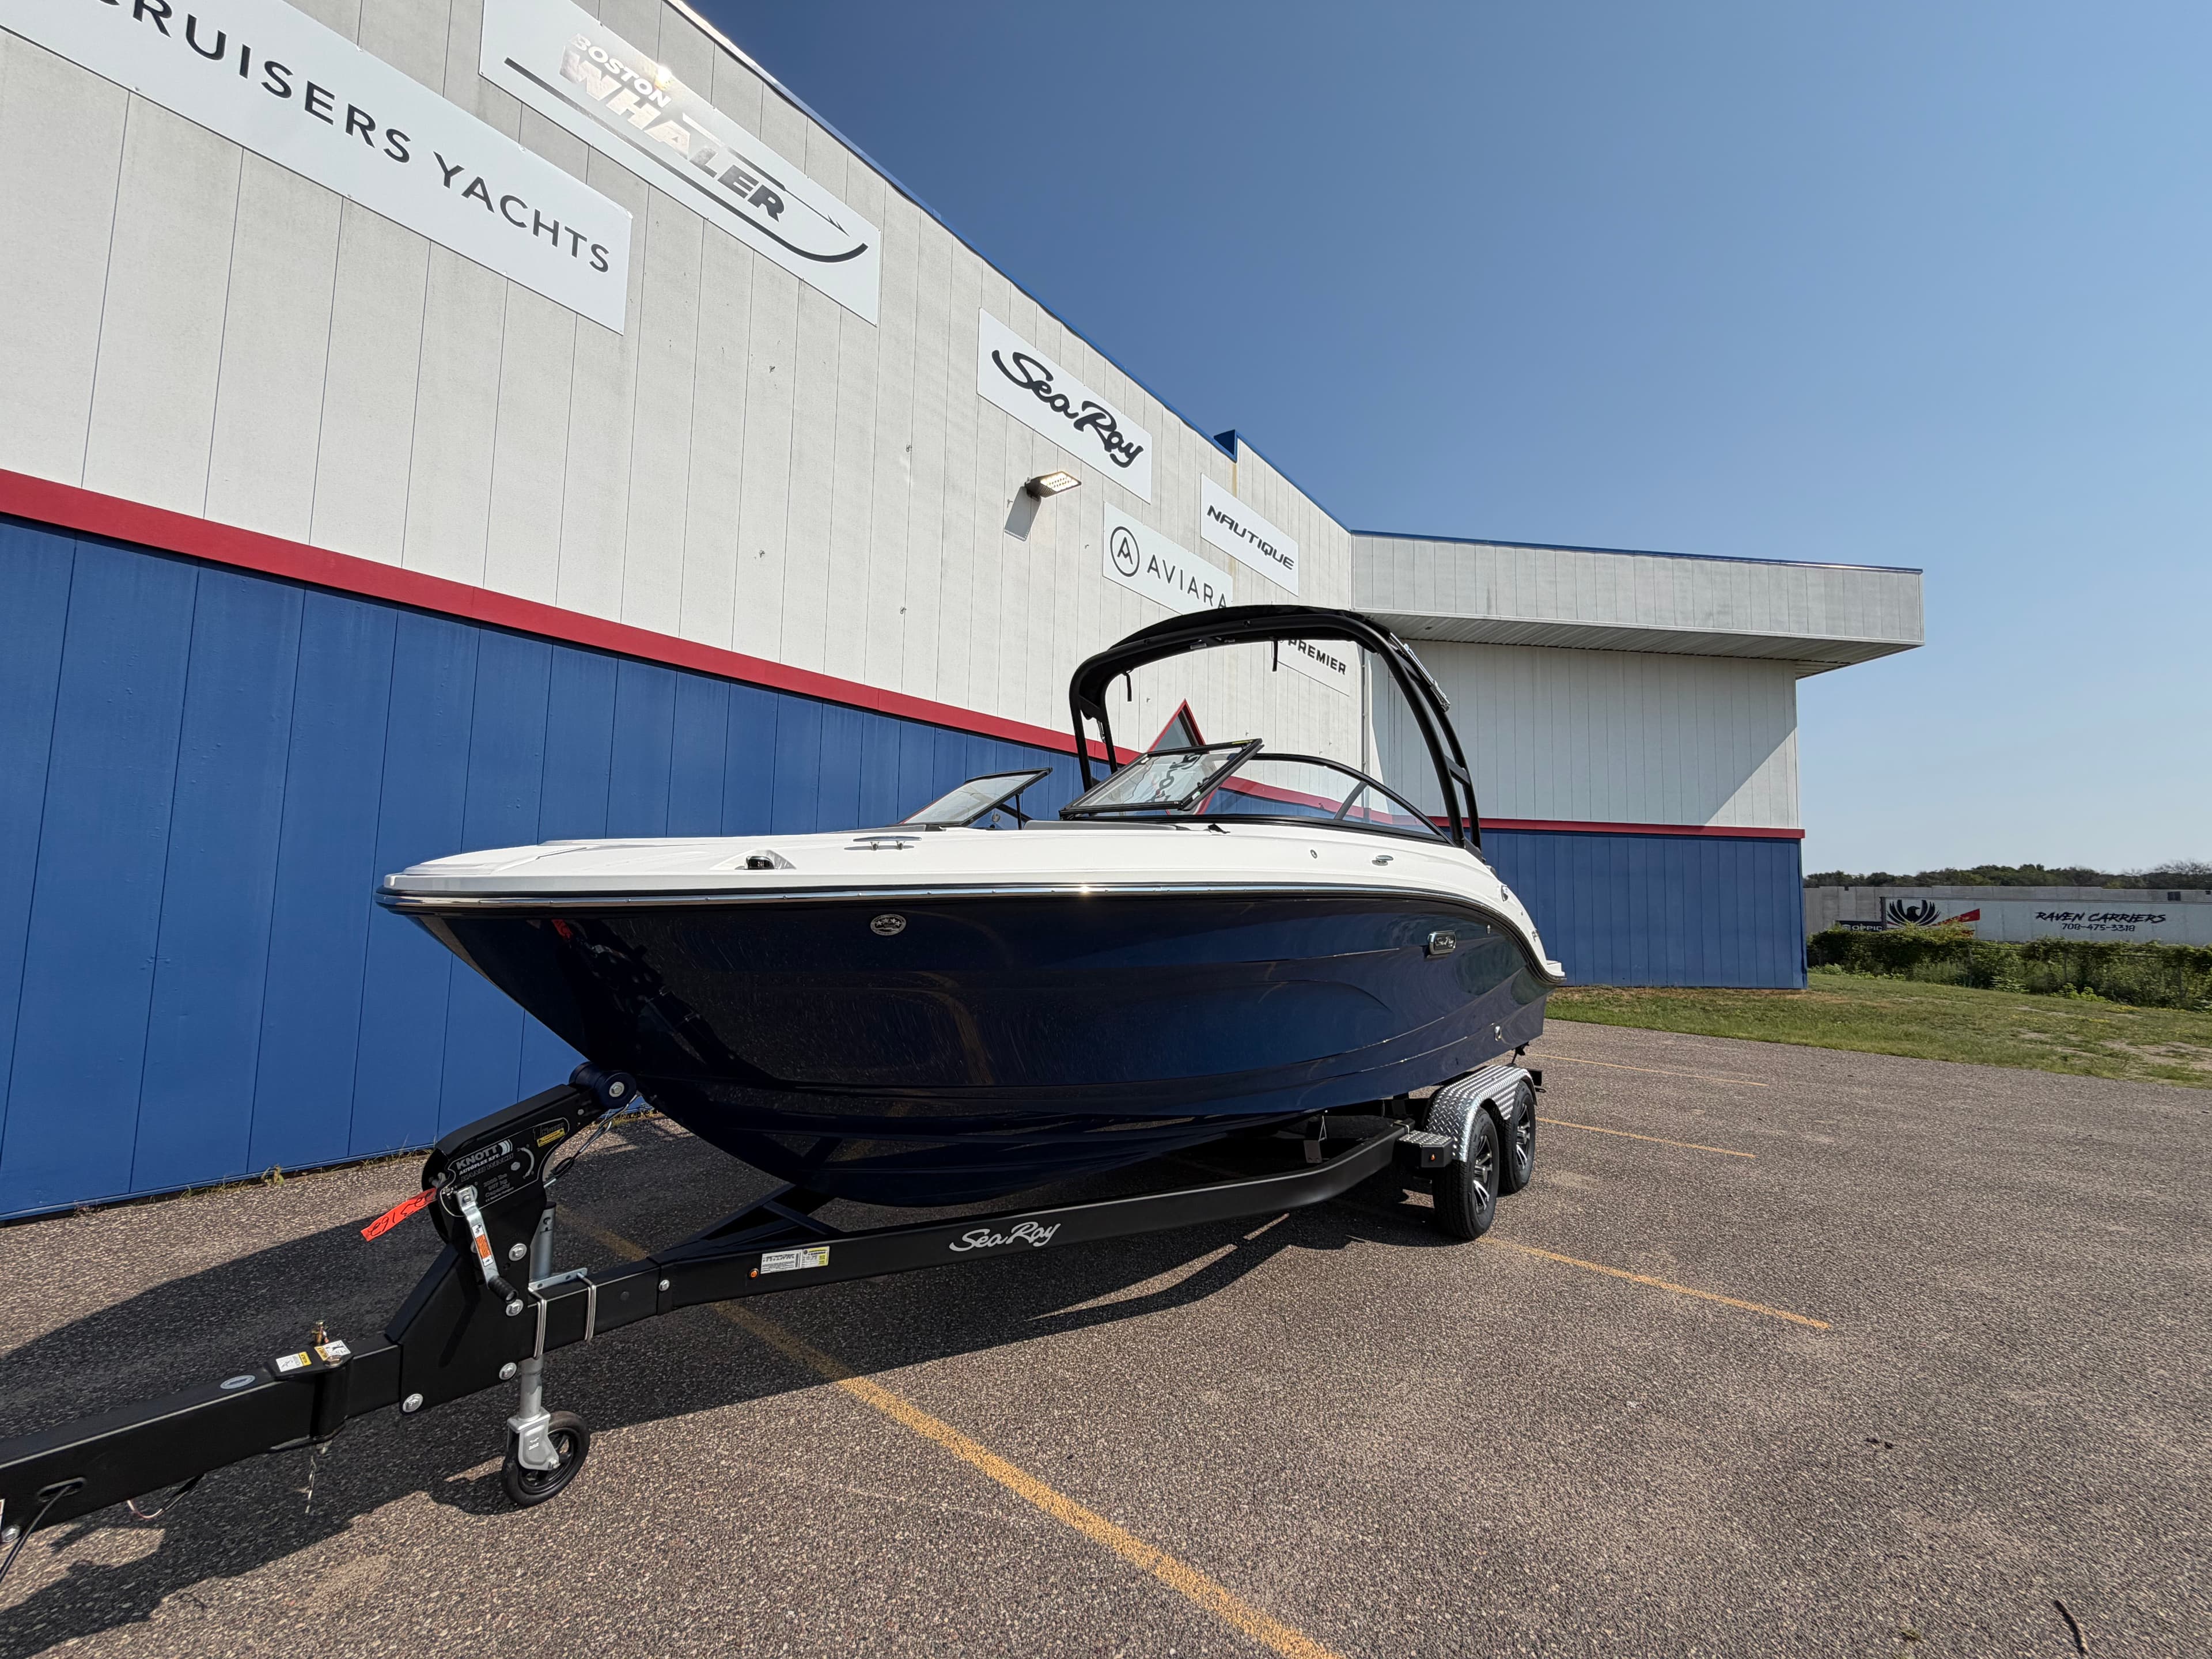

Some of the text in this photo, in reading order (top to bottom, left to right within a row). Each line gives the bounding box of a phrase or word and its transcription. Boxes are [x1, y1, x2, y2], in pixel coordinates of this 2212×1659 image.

[571, 33, 672, 108] BOSTON
[99, 0, 609, 273] RUISERS YACHTS
[559, 46, 785, 222] WHALER
[991, 350, 1144, 468] Sea Ray
[1207, 505, 1294, 570] NAUTIQUE
[1147, 554, 1227, 609] AVIARA
[2035, 912, 2166, 923] RAVEN CARRIERS
[456, 1145, 498, 1170] KNOTT
[949, 1221, 1061, 1252] Sea Ray
